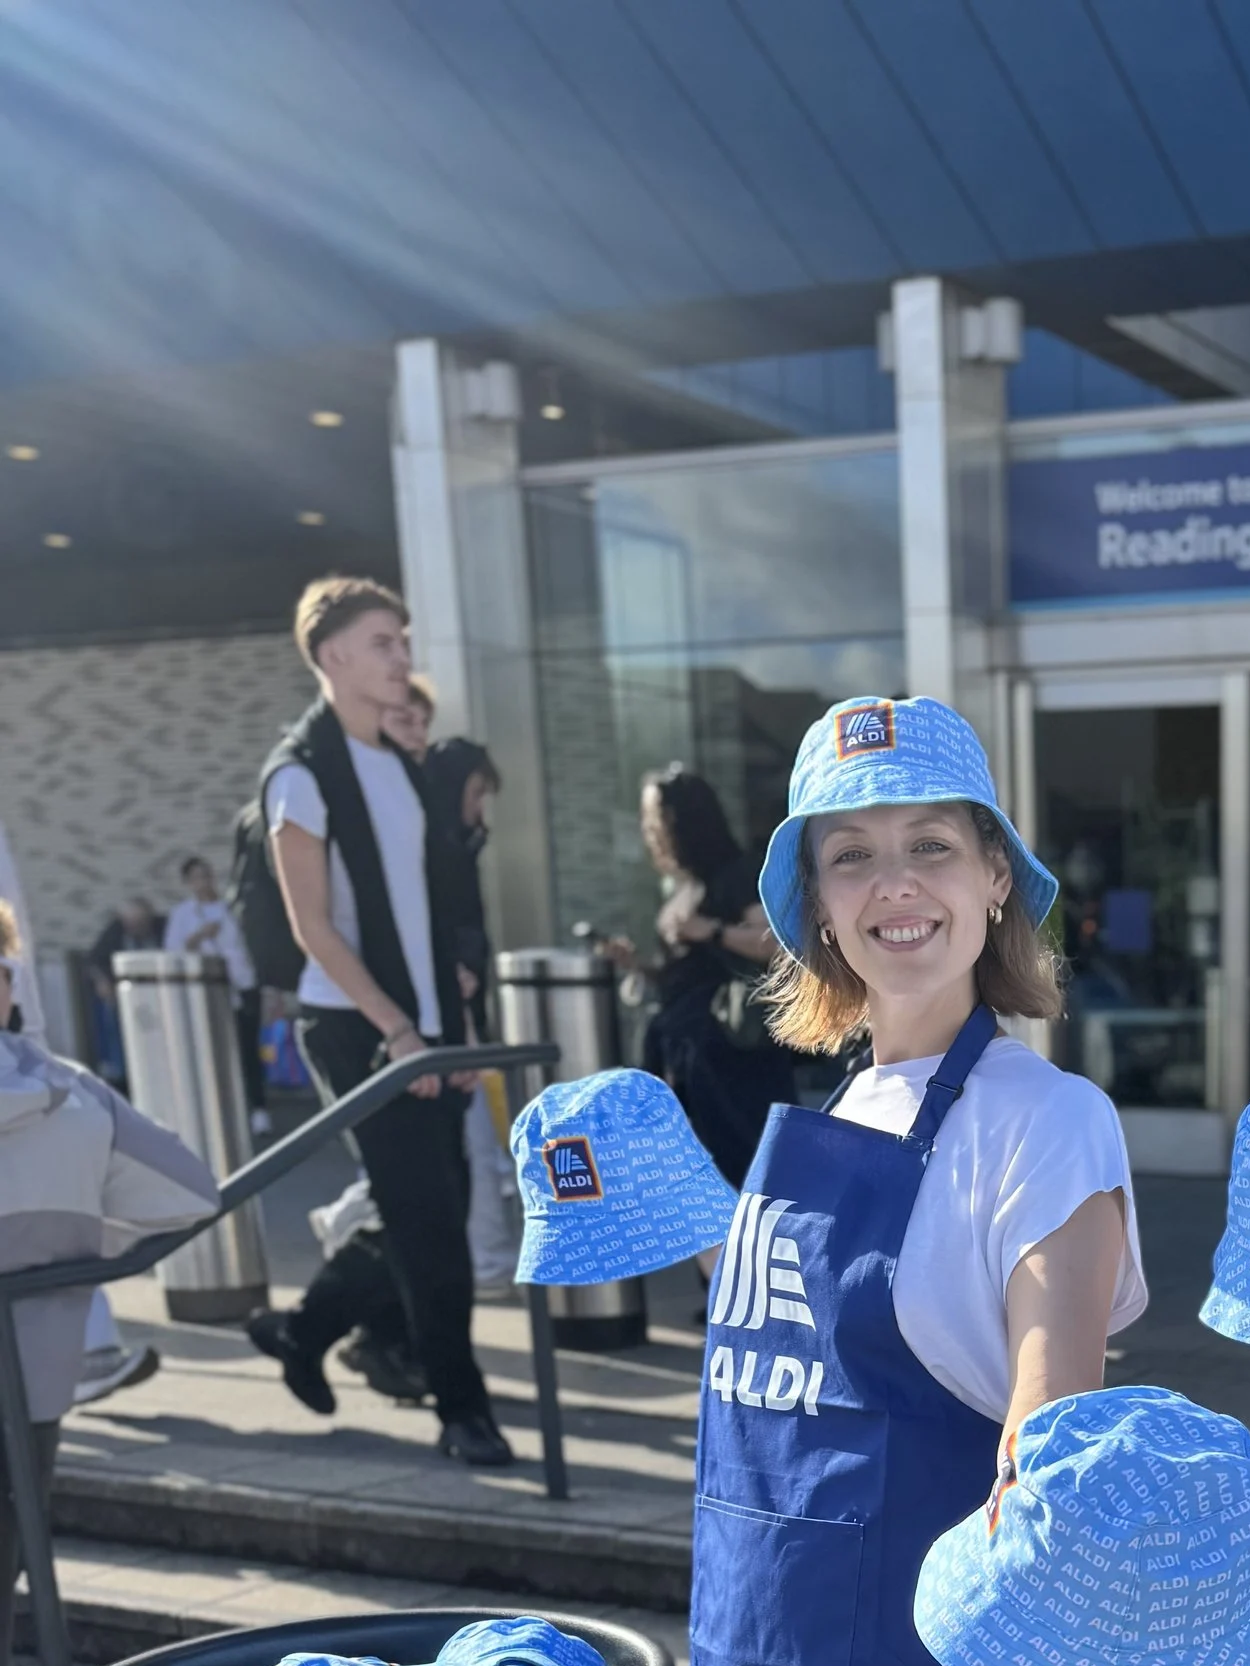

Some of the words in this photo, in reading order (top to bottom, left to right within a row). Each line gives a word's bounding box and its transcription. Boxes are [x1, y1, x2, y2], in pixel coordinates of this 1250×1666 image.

[1094, 478, 1223, 515] Welcome
[846, 730, 886, 747] ALDI
[593, 1134, 620, 1145] ALDI
[628, 1139, 653, 1150] ALDI
[597, 1150, 625, 1161] ALDI
[632, 1155, 656, 1166] ALDI
[602, 1167, 629, 1178] ALDI
[637, 1170, 663, 1183] ALDI
[668, 1170, 691, 1182] ALDI
[558, 1175, 592, 1189] ALDI
[606, 1183, 633, 1195] ALDI
[611, 1199, 639, 1211] ALDI
[653, 1207, 678, 1220] ALDI
[688, 1211, 712, 1221] ALDI
[625, 1225, 651, 1238] ALDI
[659, 1220, 686, 1234] ALDI
[694, 1226, 718, 1235] ALDI
[632, 1239, 659, 1252] ALDI
[665, 1235, 692, 1249] ALDI
[564, 1246, 590, 1263] ALDI
[604, 1255, 630, 1270] ALDI
[639, 1253, 665, 1267] ALDI
[539, 1265, 563, 1281] ALDI
[710, 1346, 823, 1416] ALDI
[1177, 1414, 1204, 1443] ALDI
[1143, 1455, 1173, 1490] ALDI
[1122, 1469, 1153, 1504] ALDI
[1048, 1488, 1085, 1518] ALDI
[1103, 1484, 1133, 1517] ALDI
[1080, 1525, 1120, 1552] ALDI
[1143, 1532, 1180, 1546] ALDI
[1072, 1543, 1110, 1571] ALDI
[1147, 1554, 1181, 1571] ALDI
[1190, 1549, 1228, 1571] ALDI
[1061, 1562, 1100, 1590] ALDI
[1150, 1576, 1189, 1592] ALDI
[1196, 1570, 1232, 1591] ALDI
[1054, 1581, 1090, 1609] ALDI
[1194, 1589, 1229, 1609] ALDI
[1044, 1598, 1081, 1628] ALDI
[1150, 1597, 1188, 1613] ALDI
[990, 1608, 1023, 1641] ALDI
[1148, 1615, 1186, 1632] ALDI
[973, 1626, 1006, 1659] ALDI
[1147, 1634, 1184, 1651] ALDI
